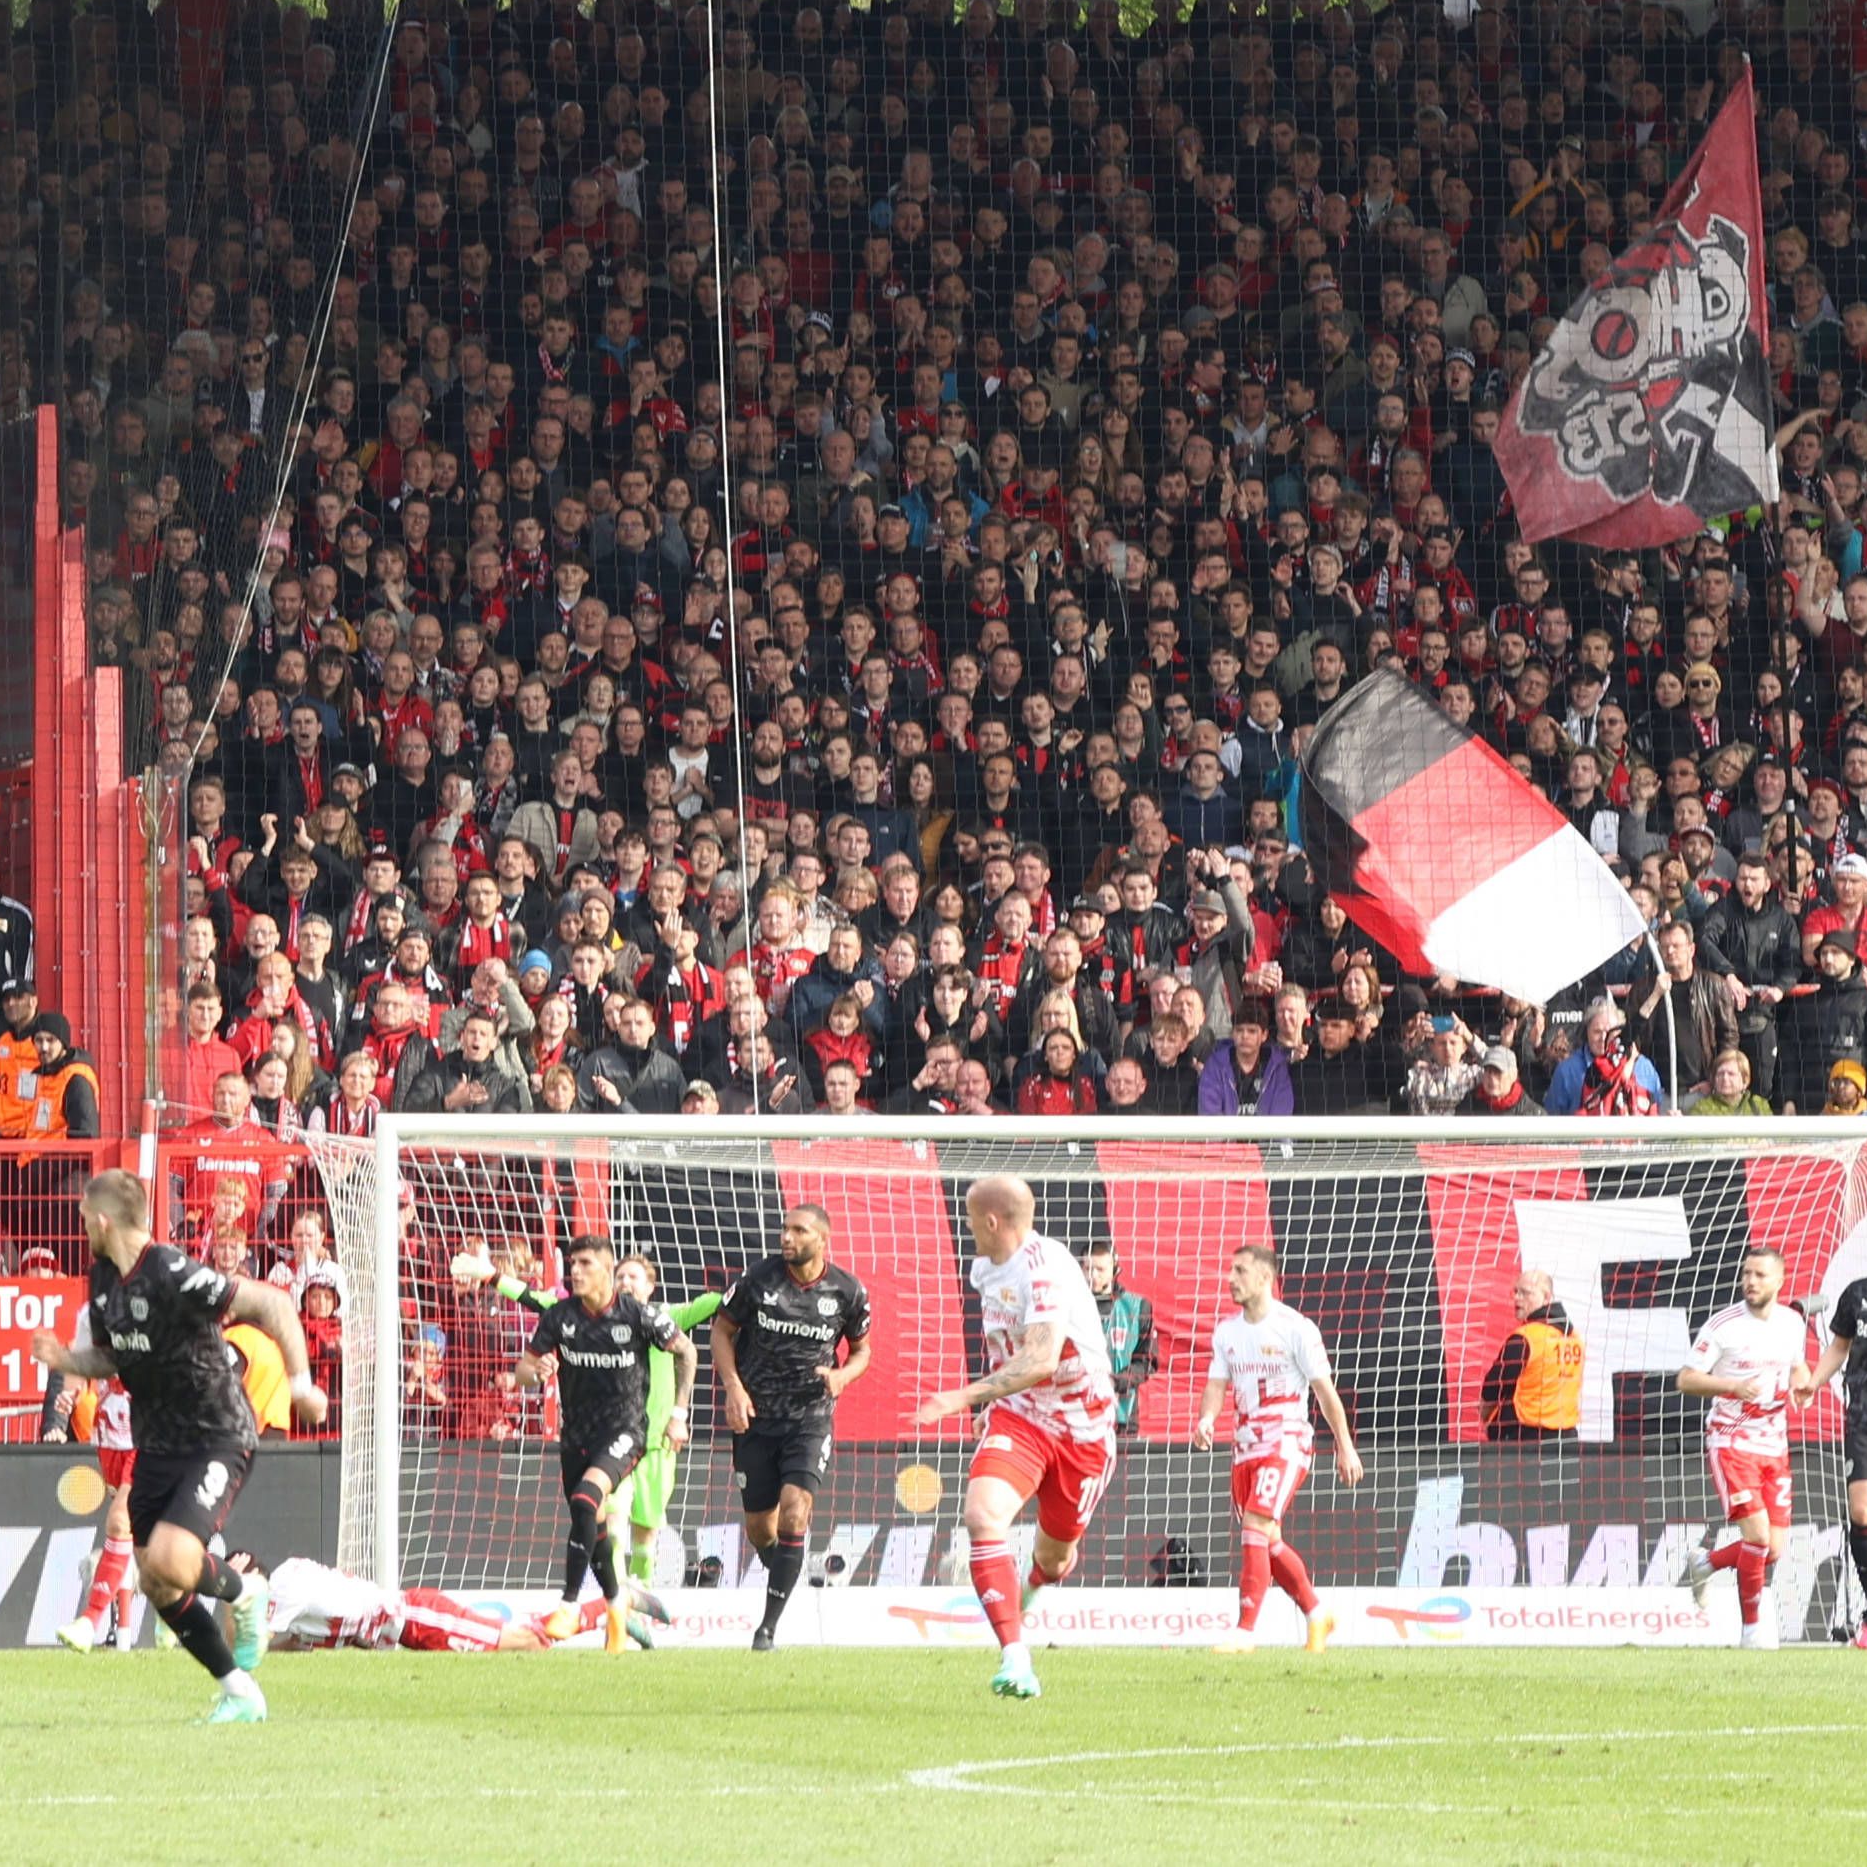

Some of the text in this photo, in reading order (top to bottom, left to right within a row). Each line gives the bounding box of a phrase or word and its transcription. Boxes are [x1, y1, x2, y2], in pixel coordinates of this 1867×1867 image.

[758, 1310, 836, 1342] Barmenia
[560, 1344, 636, 1369] Barmenia
[1255, 1467, 1282, 1497] 18
[1021, 1606, 1230, 1637] otalEnergies
[1481, 1603, 1712, 1633] TotalEnergies
